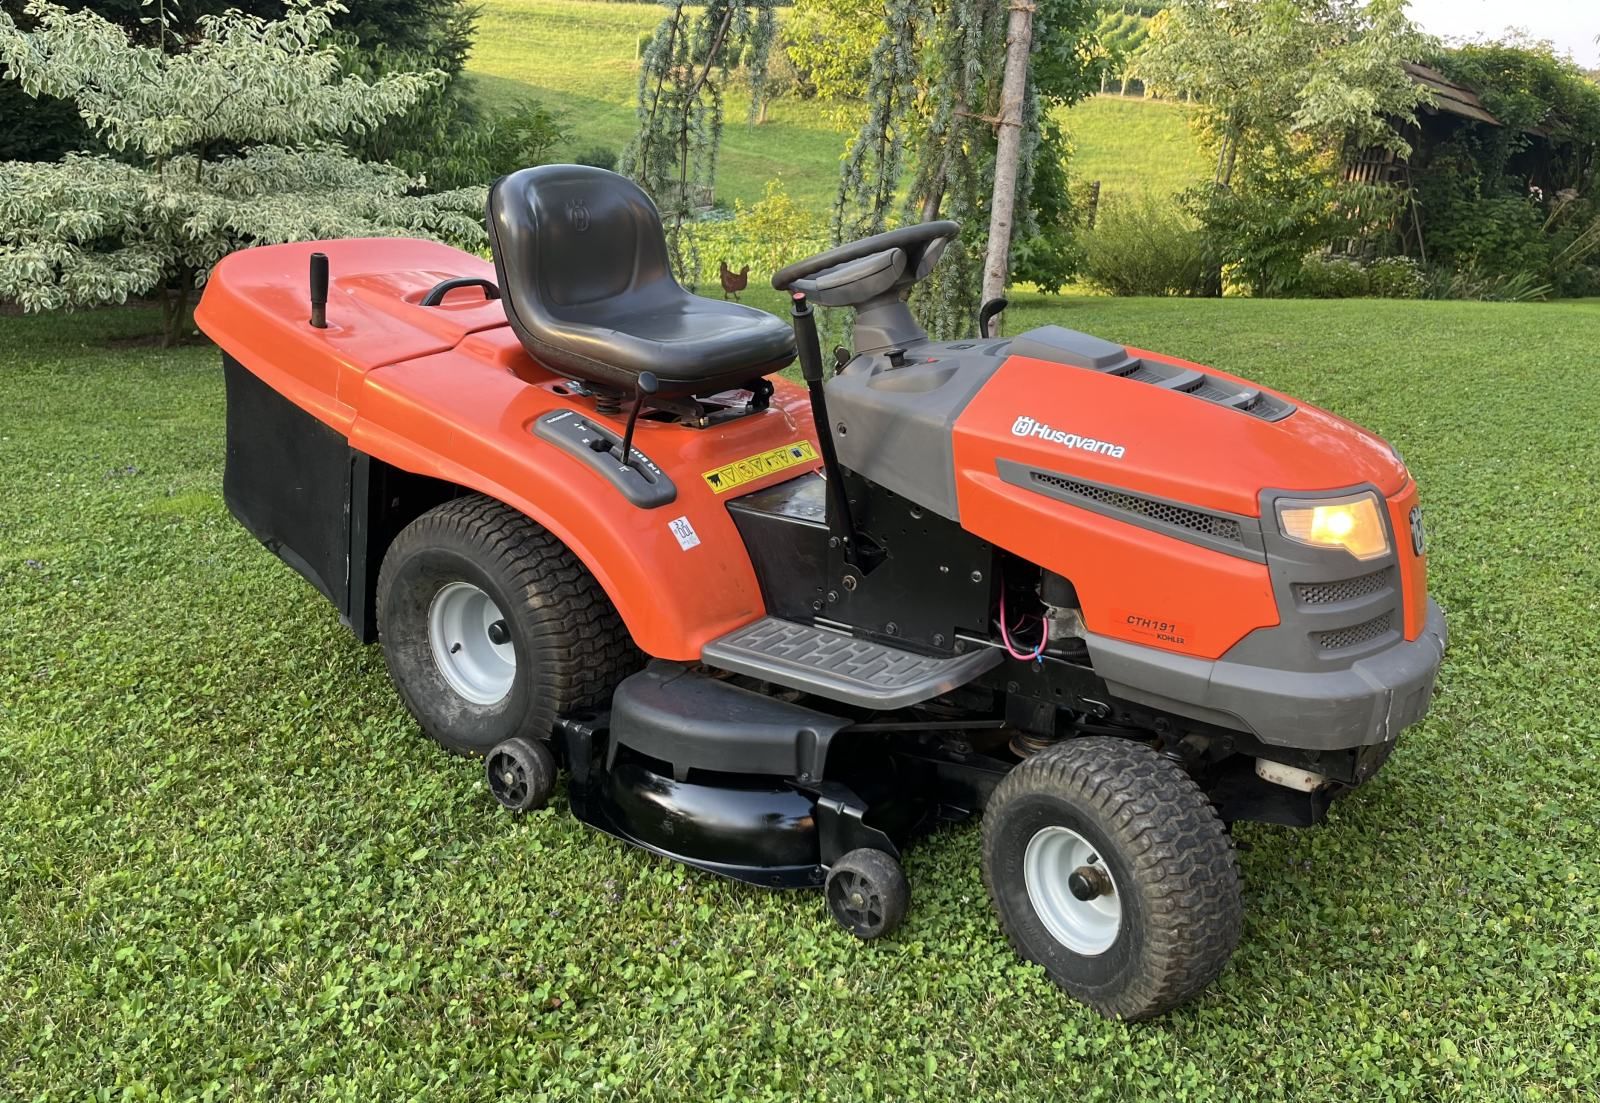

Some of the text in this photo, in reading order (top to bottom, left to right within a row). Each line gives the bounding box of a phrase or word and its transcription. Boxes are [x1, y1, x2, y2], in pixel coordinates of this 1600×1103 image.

[1030, 422, 1126, 459] Husqvarna
[1126, 615, 1176, 633] CTH191
[1156, 633, 1185, 644] KOHLER
